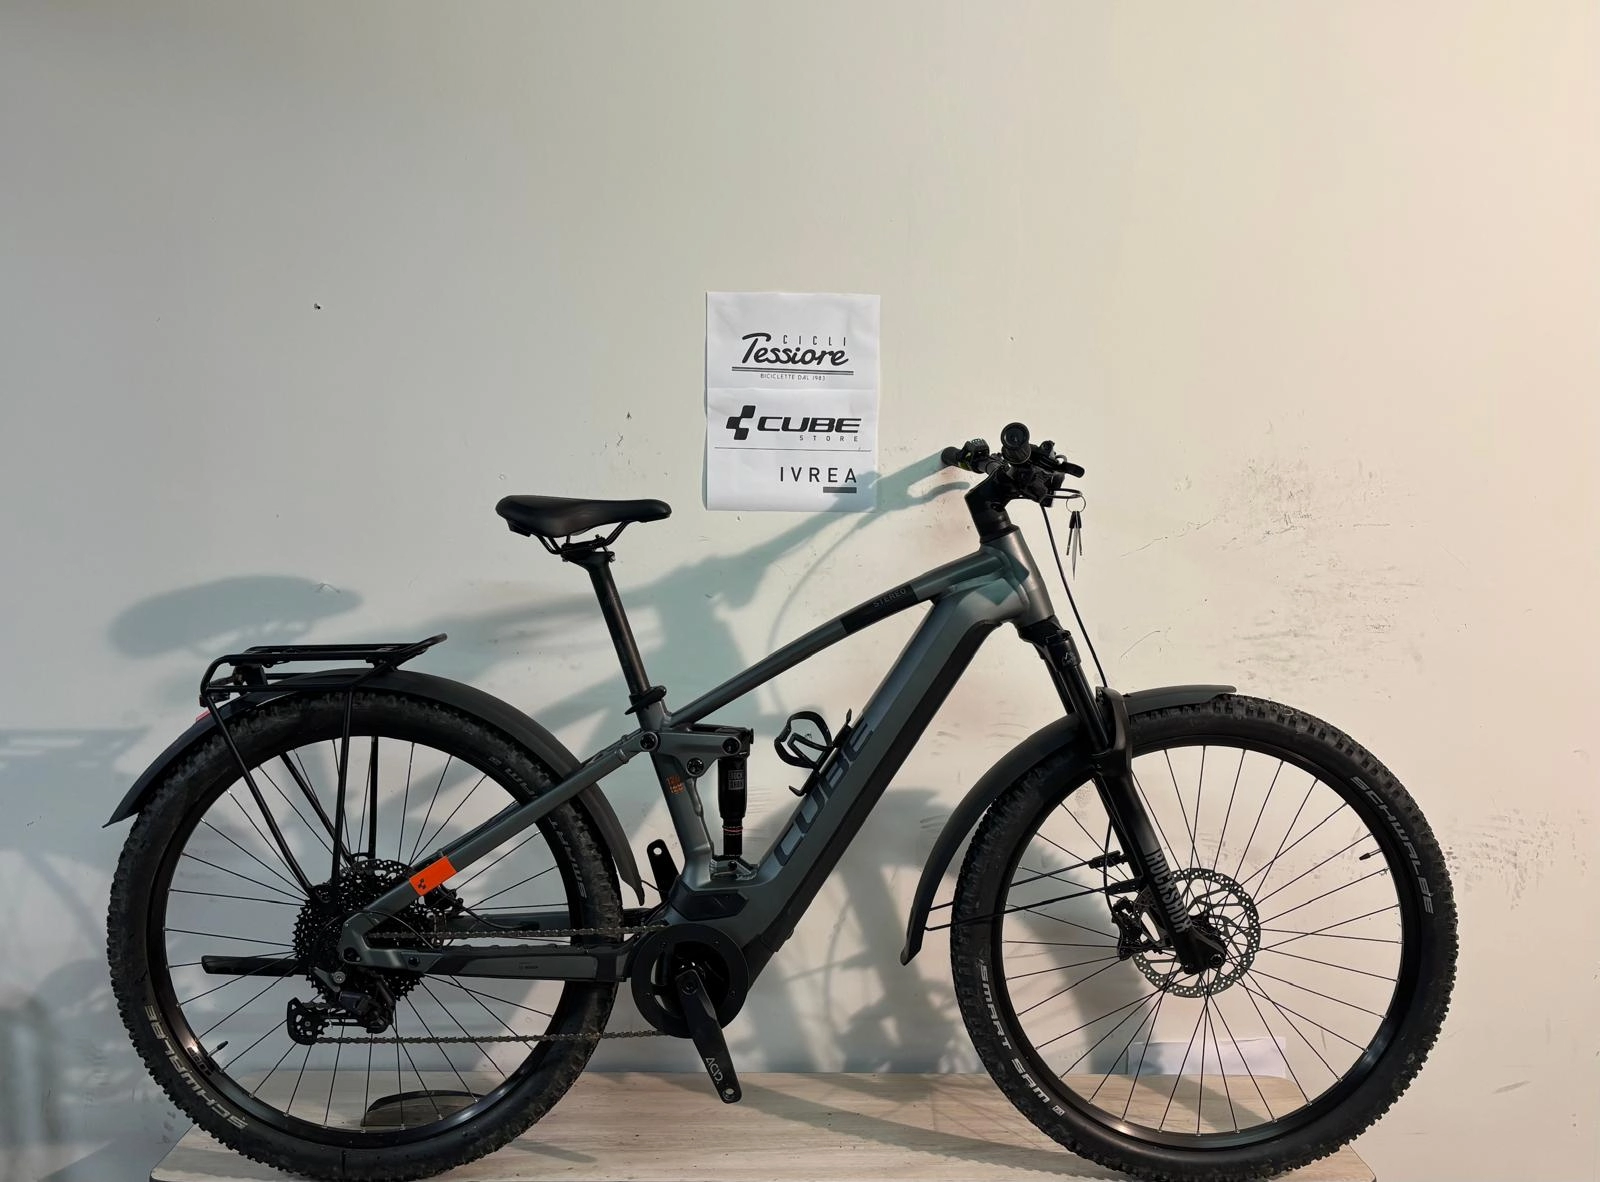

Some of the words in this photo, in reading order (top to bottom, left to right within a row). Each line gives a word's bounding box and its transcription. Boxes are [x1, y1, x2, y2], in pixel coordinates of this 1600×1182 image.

[742, 332, 849, 366] Tessiore
[783, 334, 846, 346] CICLI
[757, 416, 862, 433] CUBE
[780, 466, 857, 483] IVREA
[870, 587, 906, 608] STEREO
[774, 715, 874, 867] CUBE
[1350, 776, 1434, 914] SCHWALBE
[1144, 849, 1192, 933] ROCKSHOX
[980, 965, 1012, 1050] SMART
[1011, 1057, 1051, 1104] SAM
[144, 1005, 249, 1130] SCHWALBE
